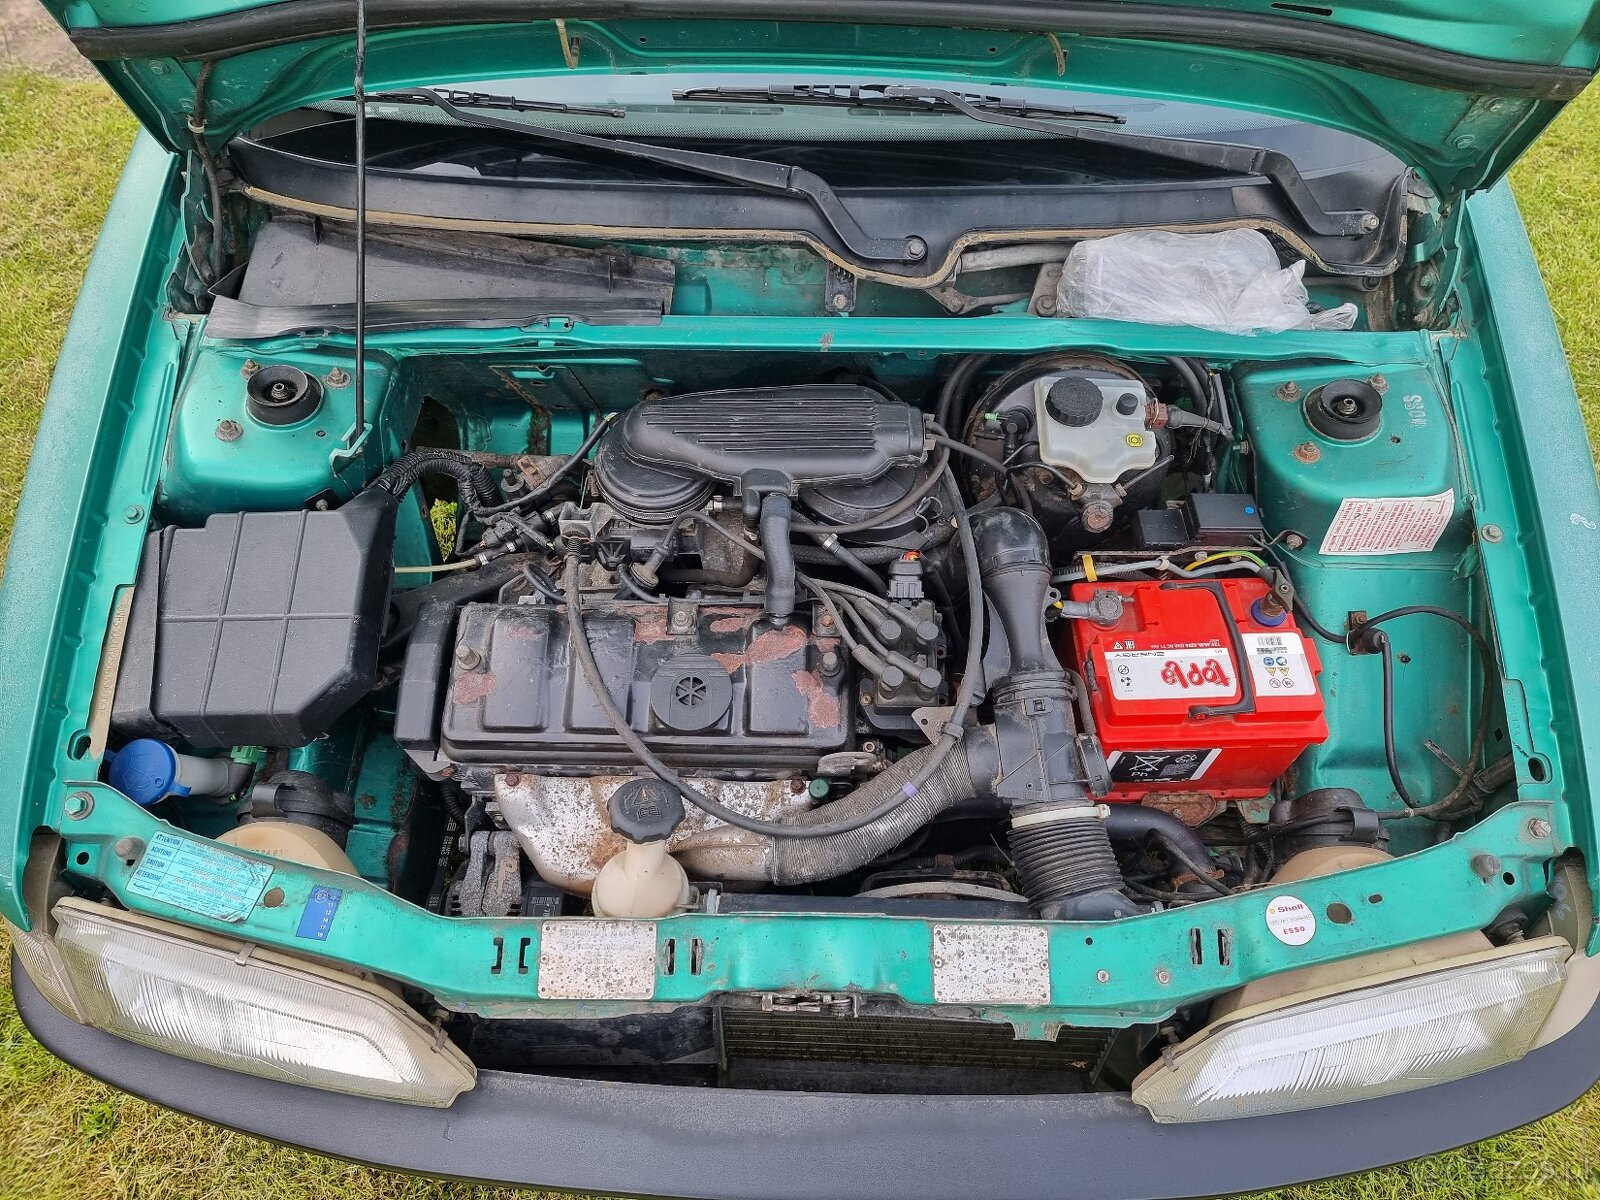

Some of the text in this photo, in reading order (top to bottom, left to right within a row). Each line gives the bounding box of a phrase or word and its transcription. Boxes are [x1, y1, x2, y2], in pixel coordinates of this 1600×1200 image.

[155, 834, 181, 846] ATTENTION
[151, 846, 172, 858] ACHTUNG
[146, 858, 166, 869] CAUTION
[136, 869, 163, 882] ATTENZIONE
[1277, 903, 1304, 913] Shell
[1283, 926, 1305, 935] ESSO
